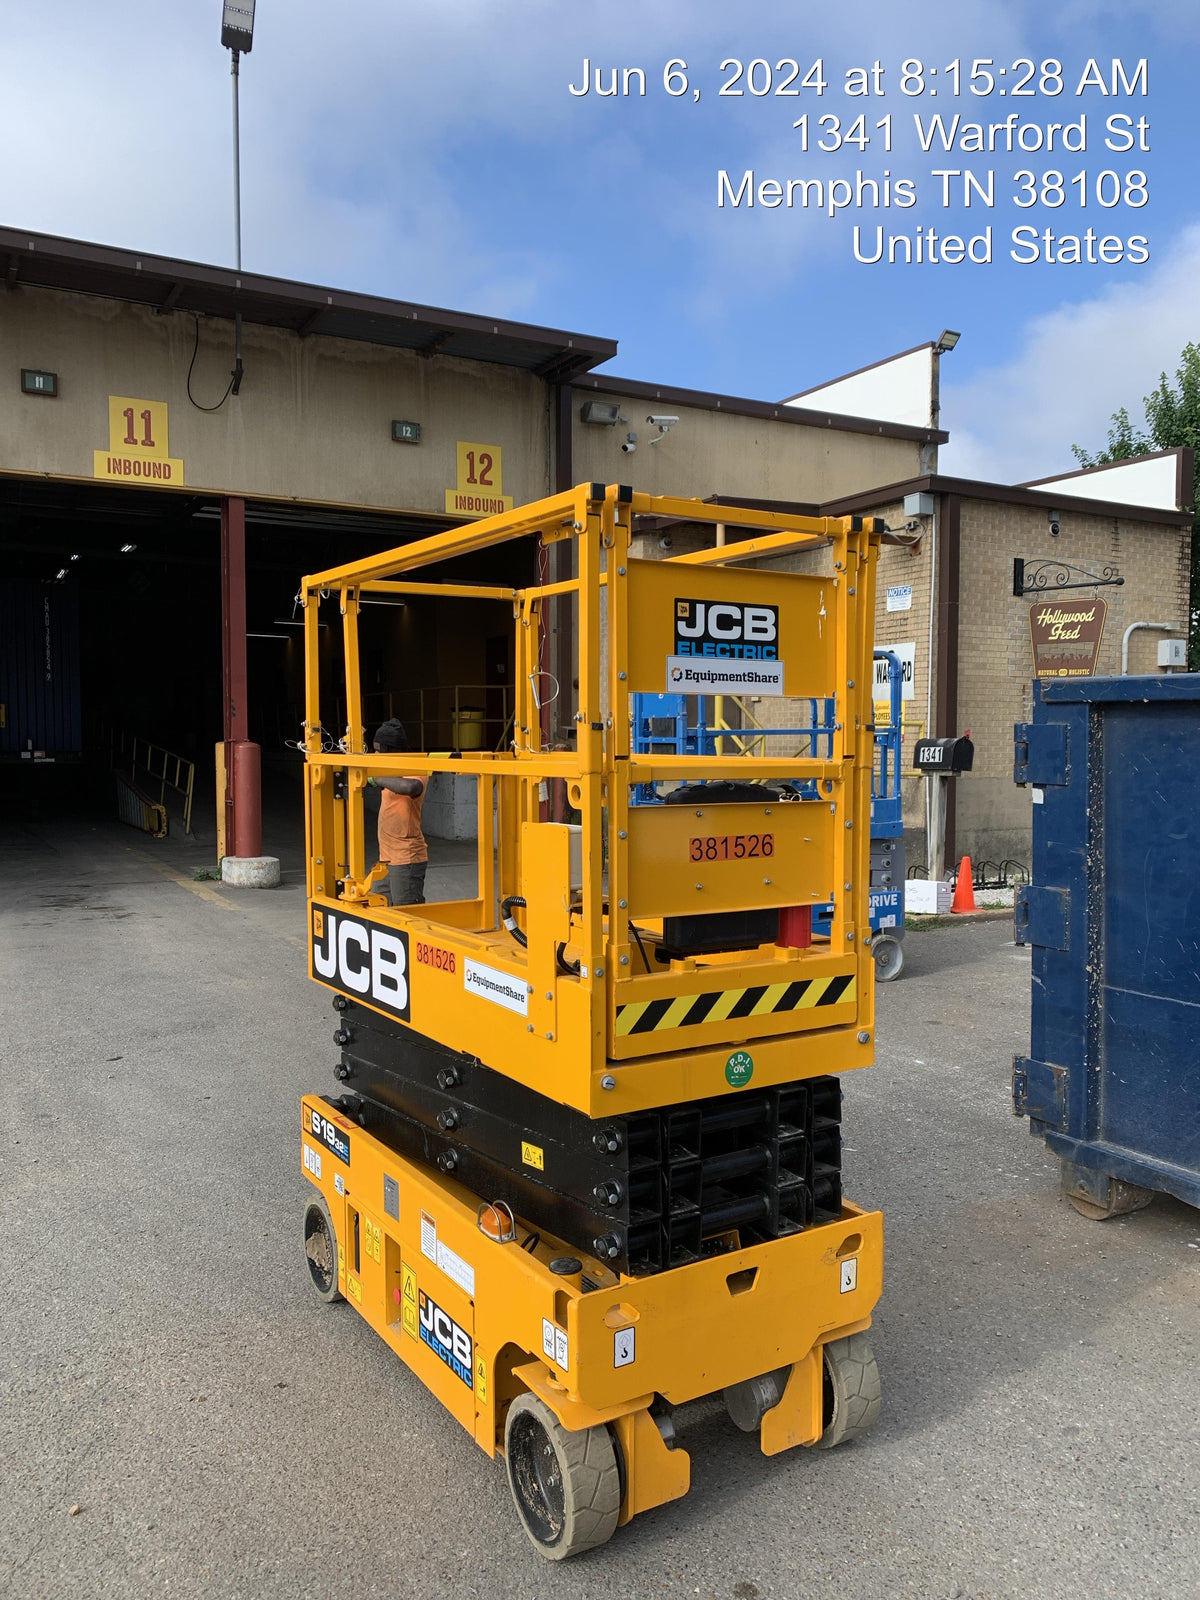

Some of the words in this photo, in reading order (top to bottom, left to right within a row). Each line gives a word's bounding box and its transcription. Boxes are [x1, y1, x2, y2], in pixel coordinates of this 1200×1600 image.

[35, 376, 44, 389] 11
[122, 407, 156, 447] 11
[402, 425, 412, 437] 12
[107, 457, 172, 480] INBOUND
[466, 450, 493, 486] 12
[455, 495, 504, 514] INBOUND
[888, 586, 912, 597] NOTICE
[677, 603, 777, 642] JCB
[1036, 606, 1096, 628] Hollywood
[1048, 623, 1081, 640] Feed
[677, 641, 777, 660] ELECTRIC
[685, 669, 779, 684] EquipmentShare
[921, 747, 942, 762] 1341
[691, 833, 773, 862] 381526
[314, 914, 408, 1011] JCB
[416, 942, 456, 974] 381526
[472, 972, 525, 1003] EquipmentShare
[733, 1065, 746, 1074] OK
[419, 1299, 472, 1370] JCB
[420, 1323, 473, 1388] ELECTRIC
